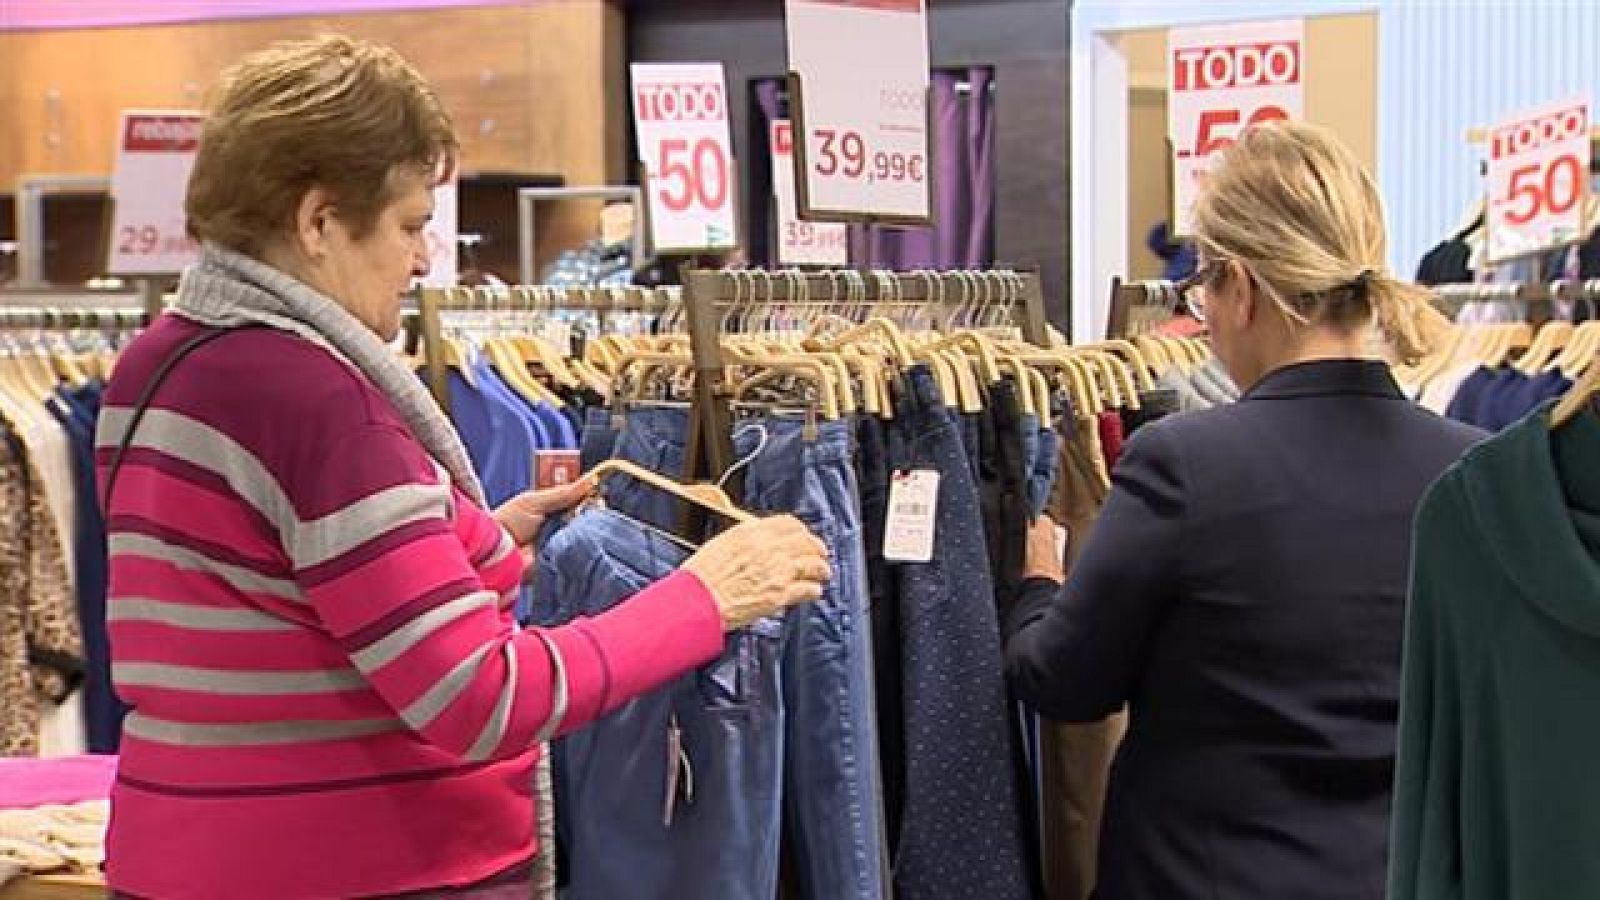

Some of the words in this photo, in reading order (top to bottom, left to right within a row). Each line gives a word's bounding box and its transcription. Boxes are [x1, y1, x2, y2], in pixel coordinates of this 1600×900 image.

[1178, 43, 1297, 90] TODO
[640, 84, 721, 120] TODO
[813, 129, 923, 184] 39,99€
[1491, 107, 1585, 159] TODO
